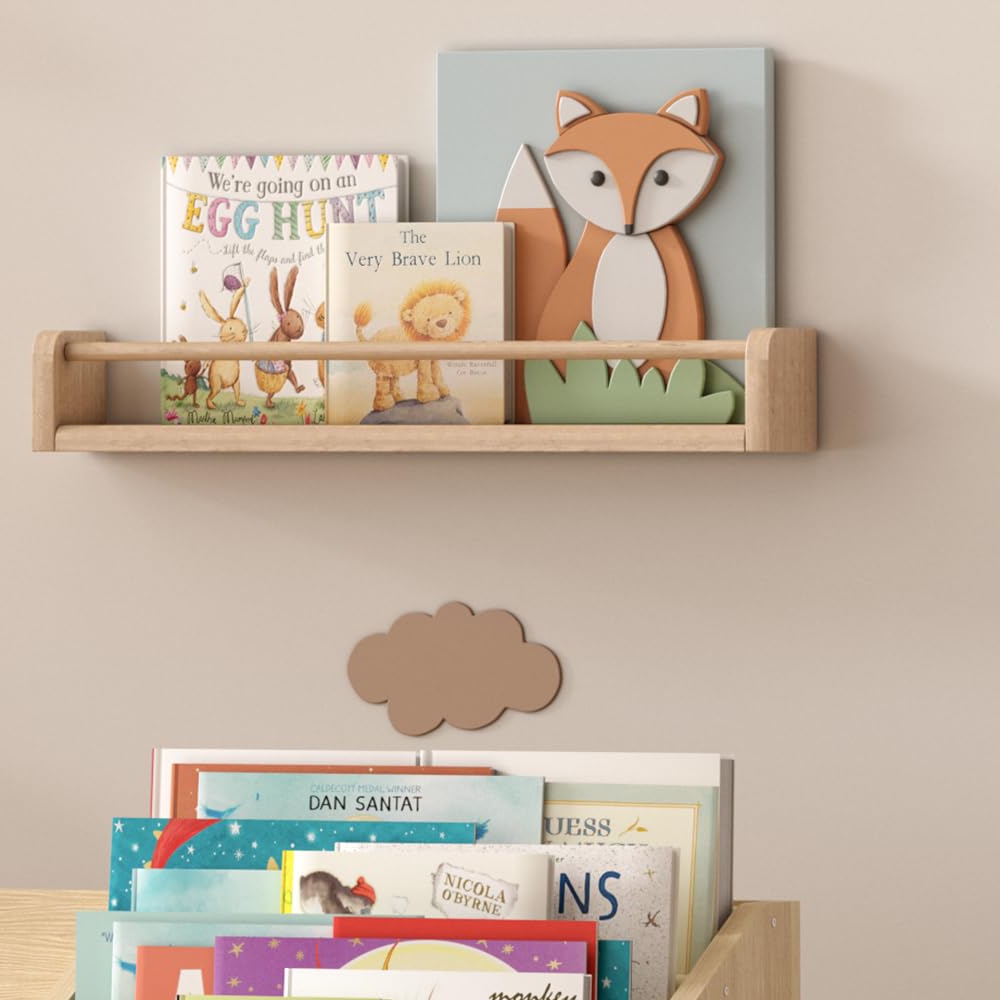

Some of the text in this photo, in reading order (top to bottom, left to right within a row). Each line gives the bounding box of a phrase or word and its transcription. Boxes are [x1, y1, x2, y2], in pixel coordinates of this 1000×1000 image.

[208, 171, 357, 199] We're going on an
[182, 189, 386, 241] EGG HUNT
[399, 229, 427, 244] The
[345, 250, 481, 273] Very Brave Lion
[357, 784, 385, 794] MEDAL
[387, 784, 422, 794] WINNER
[309, 795, 423, 812] DAN SANTAT
[444, 872, 506, 904] NICOLA
